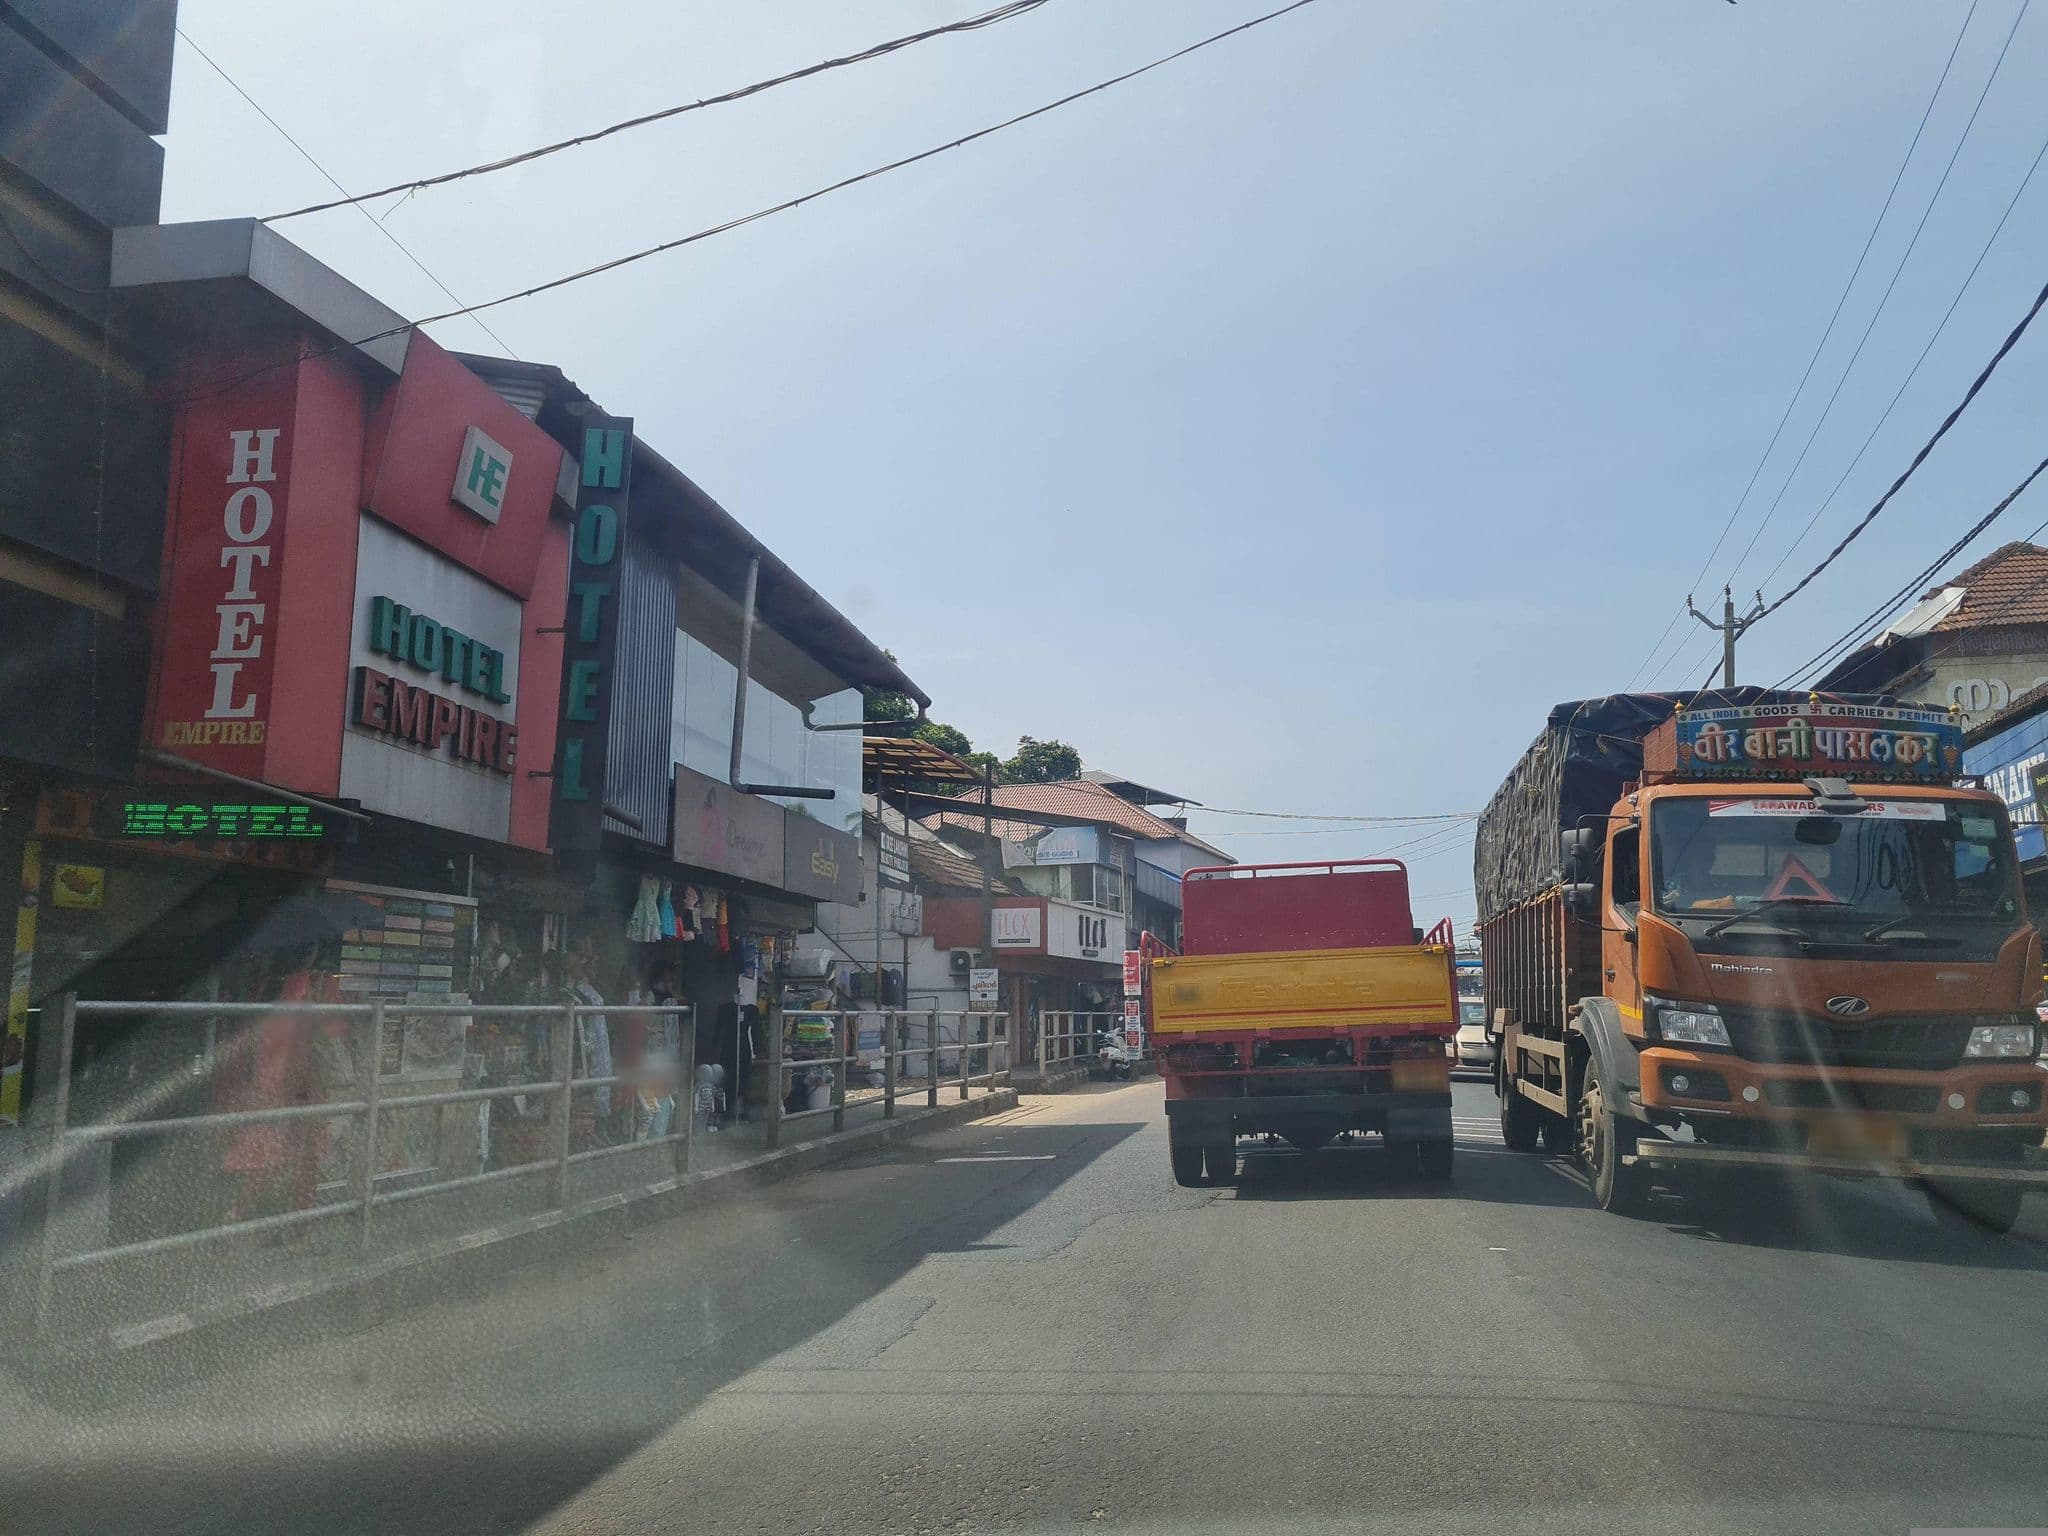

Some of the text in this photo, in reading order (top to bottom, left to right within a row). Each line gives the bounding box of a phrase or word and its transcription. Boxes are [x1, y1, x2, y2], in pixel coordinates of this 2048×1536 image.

[467, 446, 506, 507] HE
[204, 428, 281, 719] HOTEL
[561, 427, 625, 801] HOTEL
[371, 596, 511, 704] HOTEL
[163, 720, 266, 745] EMPIRE
[352, 666, 520, 774] EMPIRE
[1690, 705, 1944, 723] ALL INDIA GOODS CARRIER PERMIT
[1694, 722, 1743, 762] वीर
[123, 803, 323, 836] HOTEL
[1710, 962, 1773, 975] Mahindra
